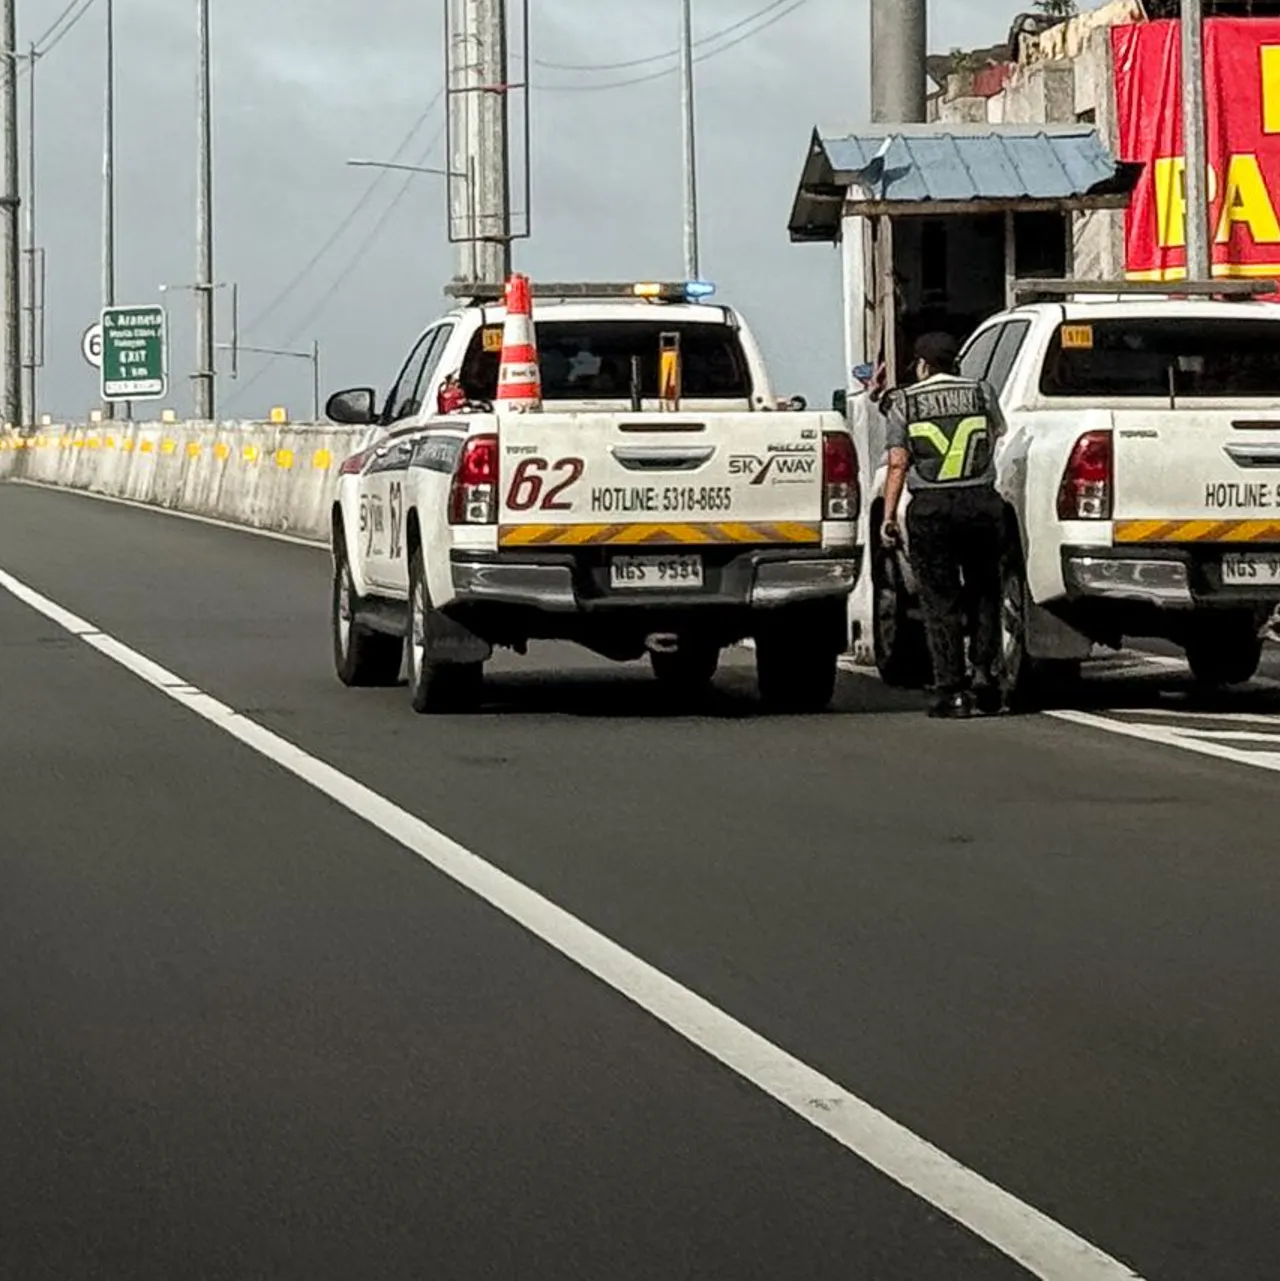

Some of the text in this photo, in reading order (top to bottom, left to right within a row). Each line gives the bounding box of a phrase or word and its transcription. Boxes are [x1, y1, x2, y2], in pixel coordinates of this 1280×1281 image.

[728, 455, 815, 485] SKYWAY
[505, 457, 585, 512] 62
[1205, 483, 1273, 508] HOTLINE:
[591, 486, 732, 512] HOTLINE: 5318-8655
[1224, 559, 1257, 578] NGS
